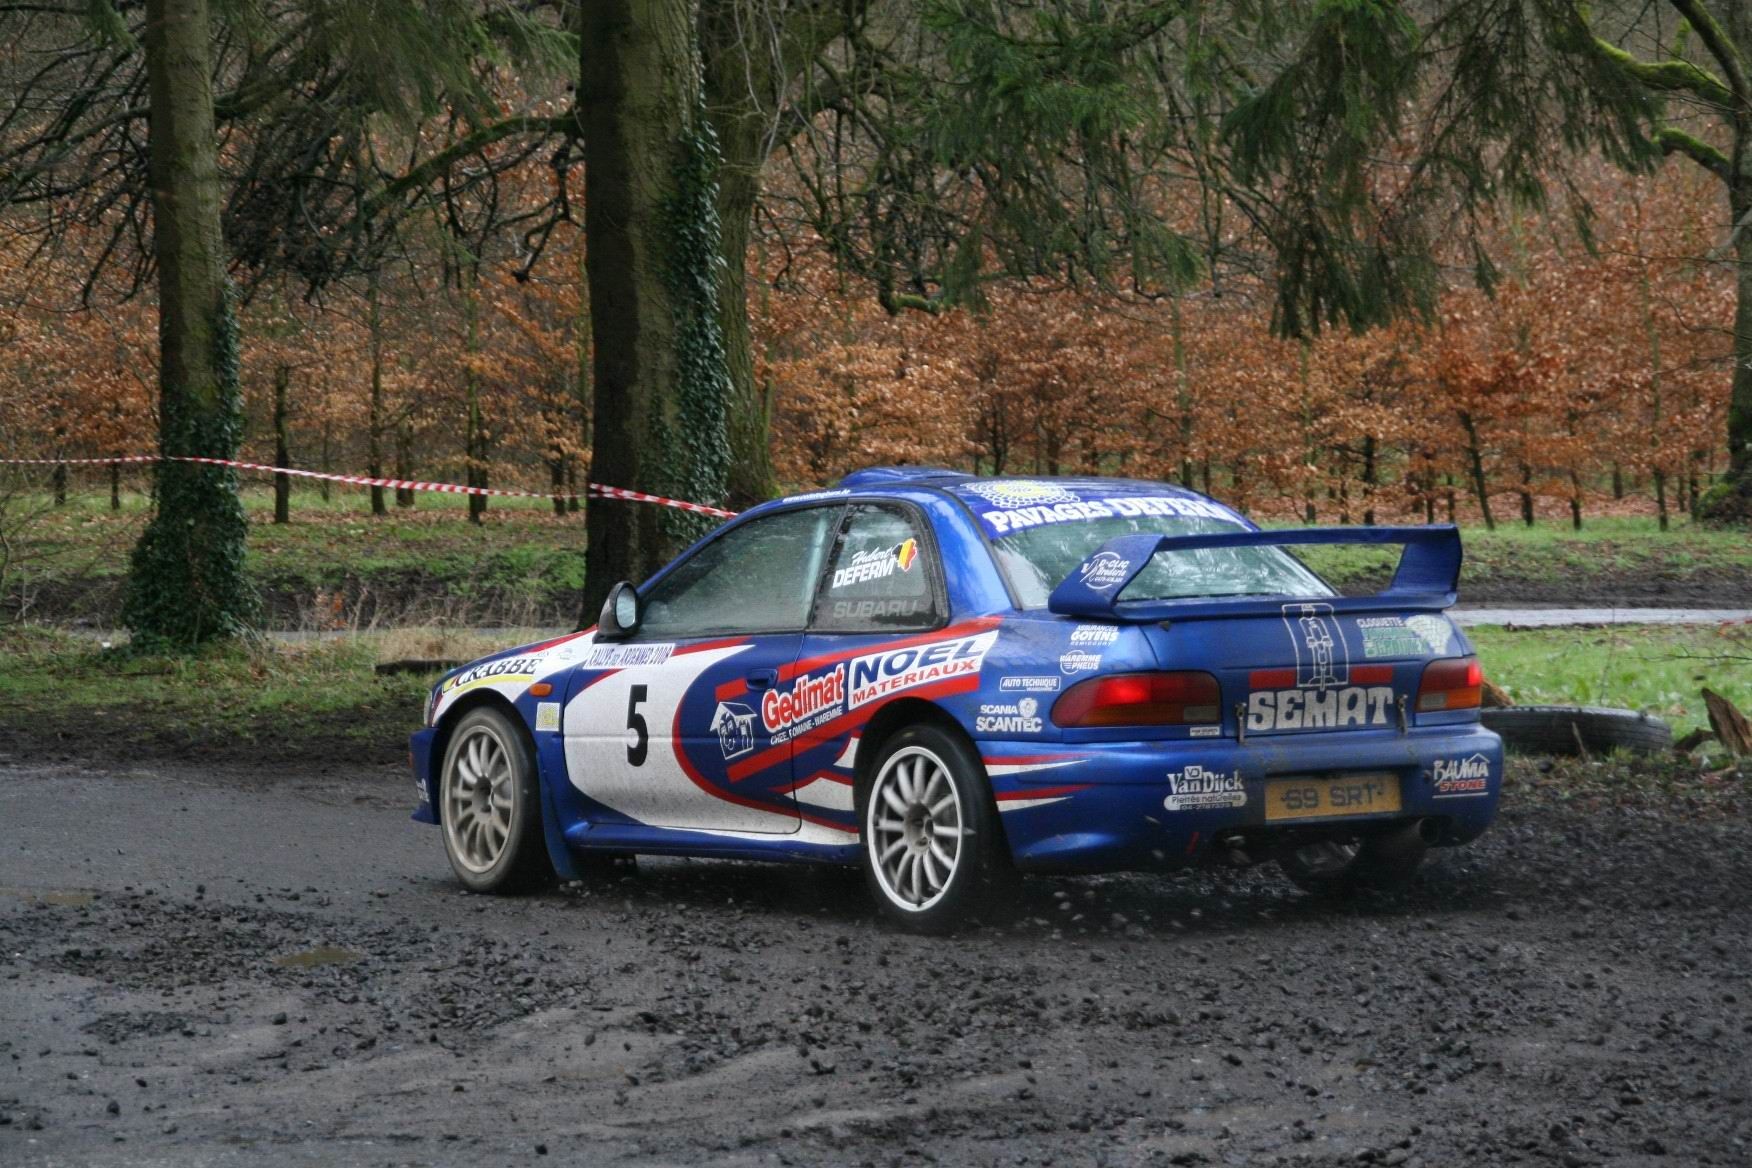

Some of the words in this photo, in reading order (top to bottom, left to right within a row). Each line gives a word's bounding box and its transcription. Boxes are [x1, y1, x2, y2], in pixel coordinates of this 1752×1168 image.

[982, 502, 1112, 533] PAVAGES
[851, 546, 894, 566] Hubert
[832, 557, 897, 589] DEFERM
[833, 600, 918, 619] SUBARU
[1070, 630, 1120, 642] GOYENS
[852, 639, 983, 690] NOEL
[1071, 662, 1100, 671] PNEUS
[852, 659, 978, 705] MATERIAUX
[1002, 678, 1021, 688] AUTO
[1022, 678, 1058, 688] TECHNIQUE
[762, 663, 845, 733] Gedimat
[980, 703, 1019, 715] SCANIA
[1247, 687, 1394, 730] SEMAT
[626, 684, 649, 767] 5
[975, 716, 1043, 733] SCANTEC
[1432, 758, 1490, 788] BAUMA
[1439, 778, 1487, 792] STONE
[1329, 783, 1378, 807] SRT
